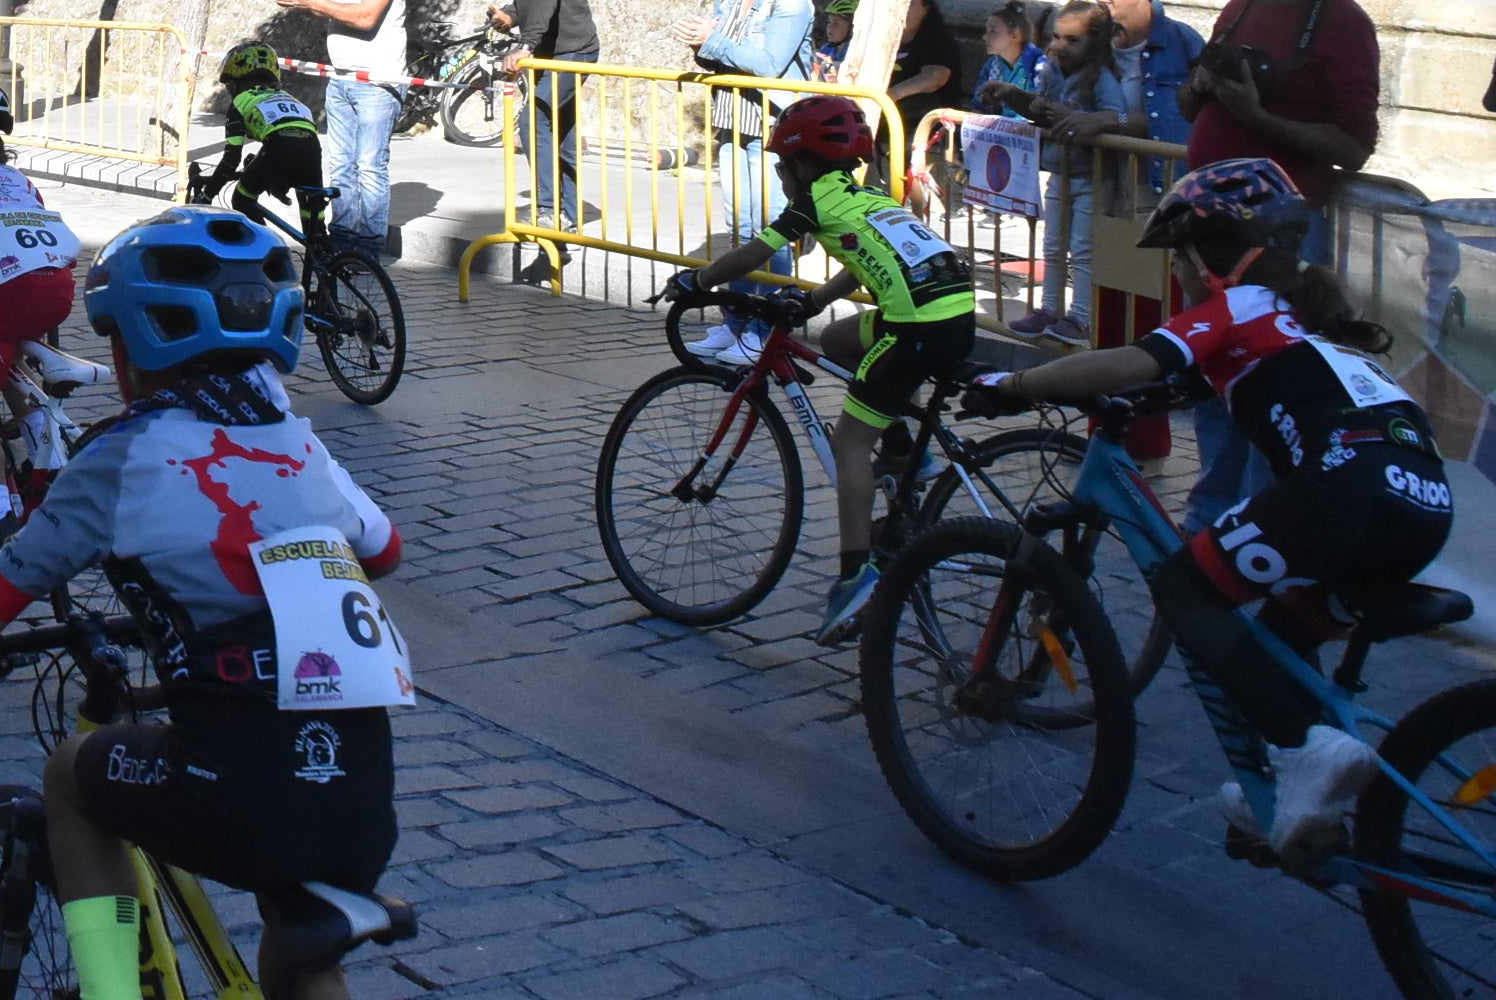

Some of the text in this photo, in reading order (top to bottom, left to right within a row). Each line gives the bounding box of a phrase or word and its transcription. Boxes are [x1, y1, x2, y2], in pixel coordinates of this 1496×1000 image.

[277, 103, 300, 114] 64
[15, 228, 58, 249] 60
[1, 262, 22, 276] bmk
[857, 247, 894, 291] BEHER
[790, 394, 821, 439] BMC
[260, 540, 342, 565] ESCUELA
[295, 678, 342, 694] bmk
